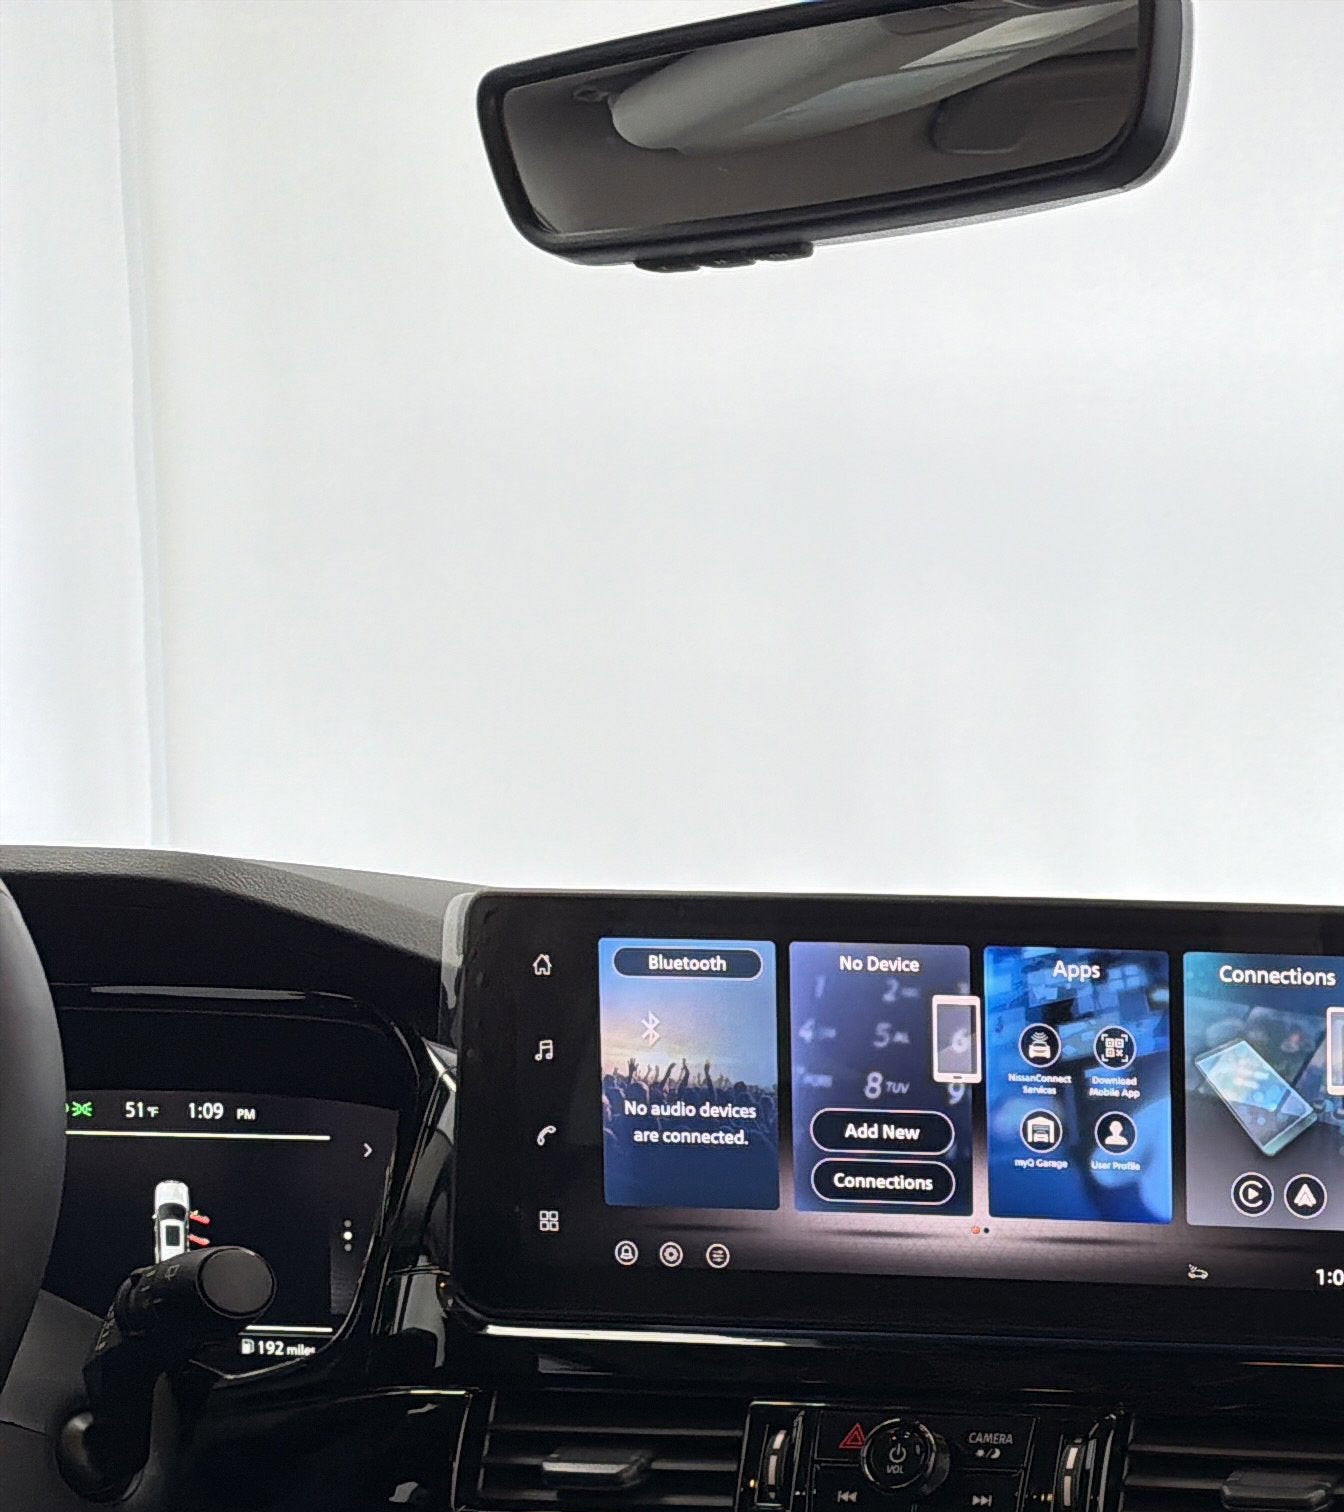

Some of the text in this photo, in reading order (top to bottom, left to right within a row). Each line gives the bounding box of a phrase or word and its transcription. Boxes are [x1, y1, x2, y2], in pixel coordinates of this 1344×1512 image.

[648, 954, 727, 971] Bluetooth
[839, 955, 920, 972] No Device
[1052, 960, 1100, 982] Apps
[1218, 965, 1337, 987] Connections
[864, 1071, 911, 1100] 8 TUV
[1008, 1072, 1072, 1084] NissanConnect
[1091, 1076, 1138, 1086] Download
[1022, 1085, 1057, 1095] Services
[1089, 1087, 1141, 1099] Mobile App
[188, 1102, 256, 1120] 1:09 PM
[624, 1101, 757, 1119] No audio devices
[633, 1128, 749, 1146] are connected.
[844, 1123, 921, 1141] Add New
[1036, 1159, 1069, 1170] Garage
[1090, 1159, 1141, 1171] User Profile
[833, 1172, 934, 1192] Connections
[258, 1340, 284, 1356] 192
[968, 1432, 1014, 1445] CAMERA
[886, 1464, 905, 1474] VOL
